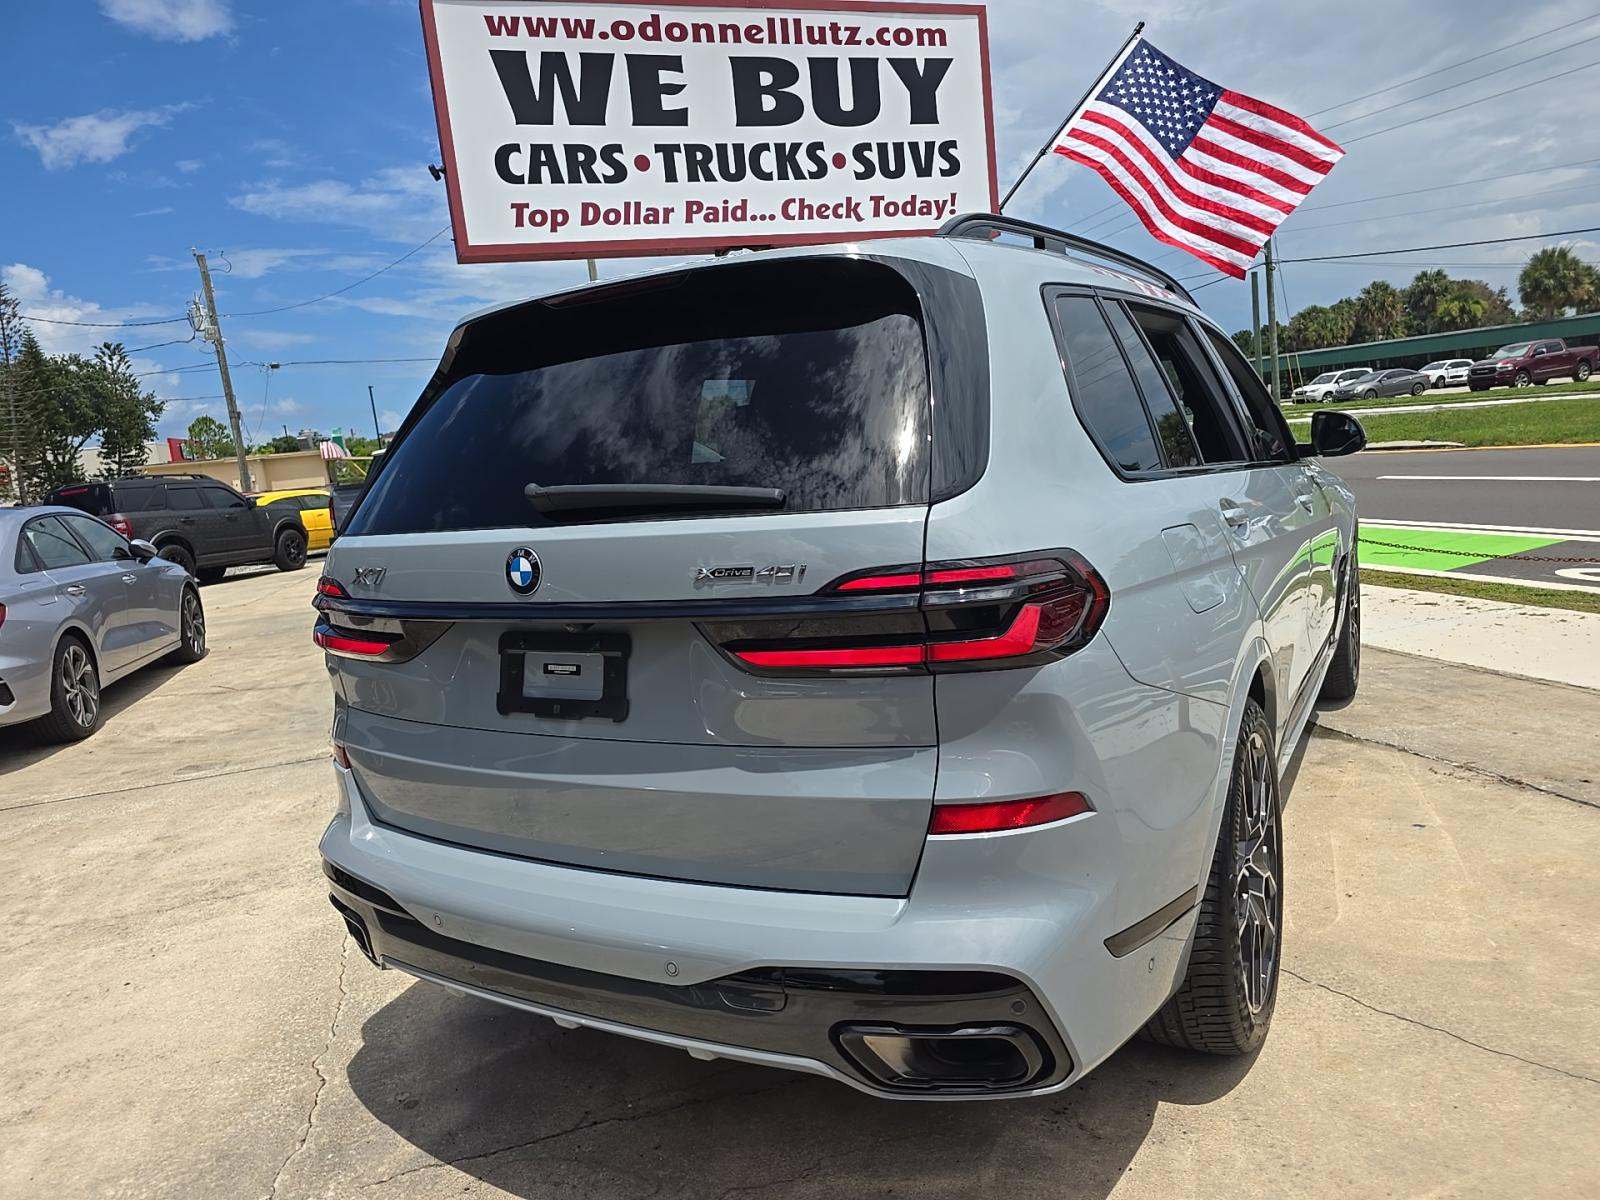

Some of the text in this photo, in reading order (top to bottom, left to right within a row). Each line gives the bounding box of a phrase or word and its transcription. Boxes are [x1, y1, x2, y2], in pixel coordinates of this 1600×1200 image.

[483, 13, 948, 47] www.odonnelllutz.com
[488, 48, 954, 128] WE BUY
[494, 139, 961, 185] CARS TRUCKS SUVS
[510, 192, 957, 233] Top Dollar Paid... Check Today!
[352, 567, 388, 585] X7
